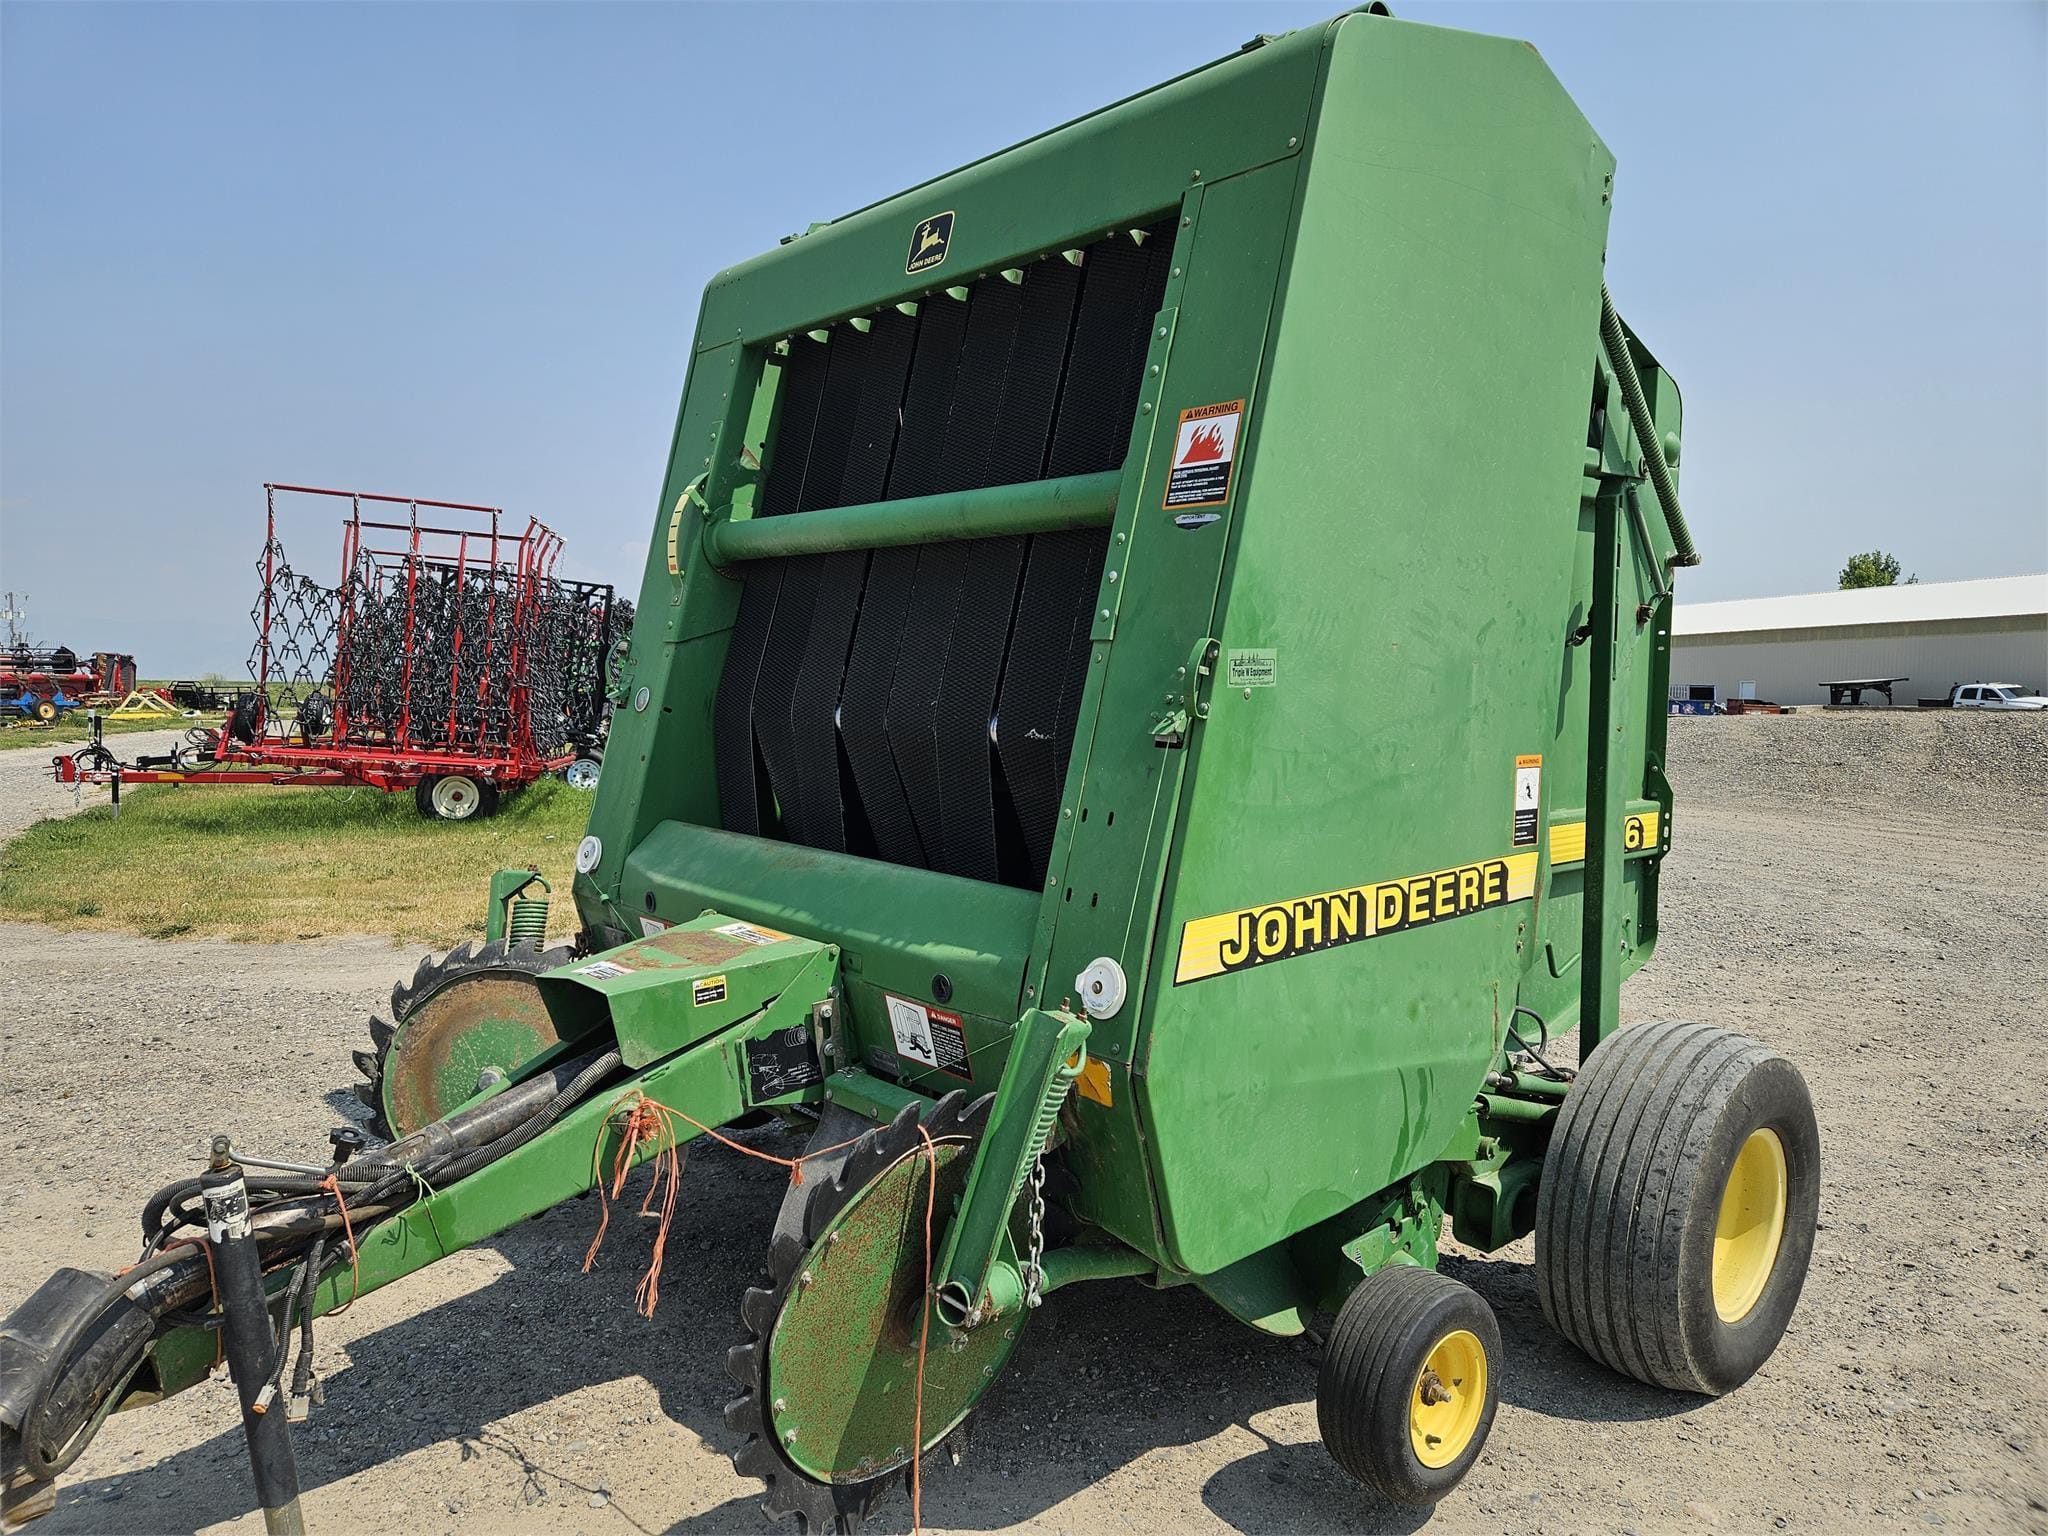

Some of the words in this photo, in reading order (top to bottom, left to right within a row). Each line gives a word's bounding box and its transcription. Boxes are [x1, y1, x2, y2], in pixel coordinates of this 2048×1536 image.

[908, 259, 924, 271] JOHN
[923, 253, 943, 265] DEERE
[1193, 401, 1239, 417] WARNING
[1232, 667, 1245, 677] Triple
[1250, 667, 1273, 677] Equipment
[1220, 891, 1367, 969] JOHN
[1375, 861, 1509, 936] DEERE
[700, 978, 724, 987] CAUTION
[936, 1013, 957, 1025] DANGER
